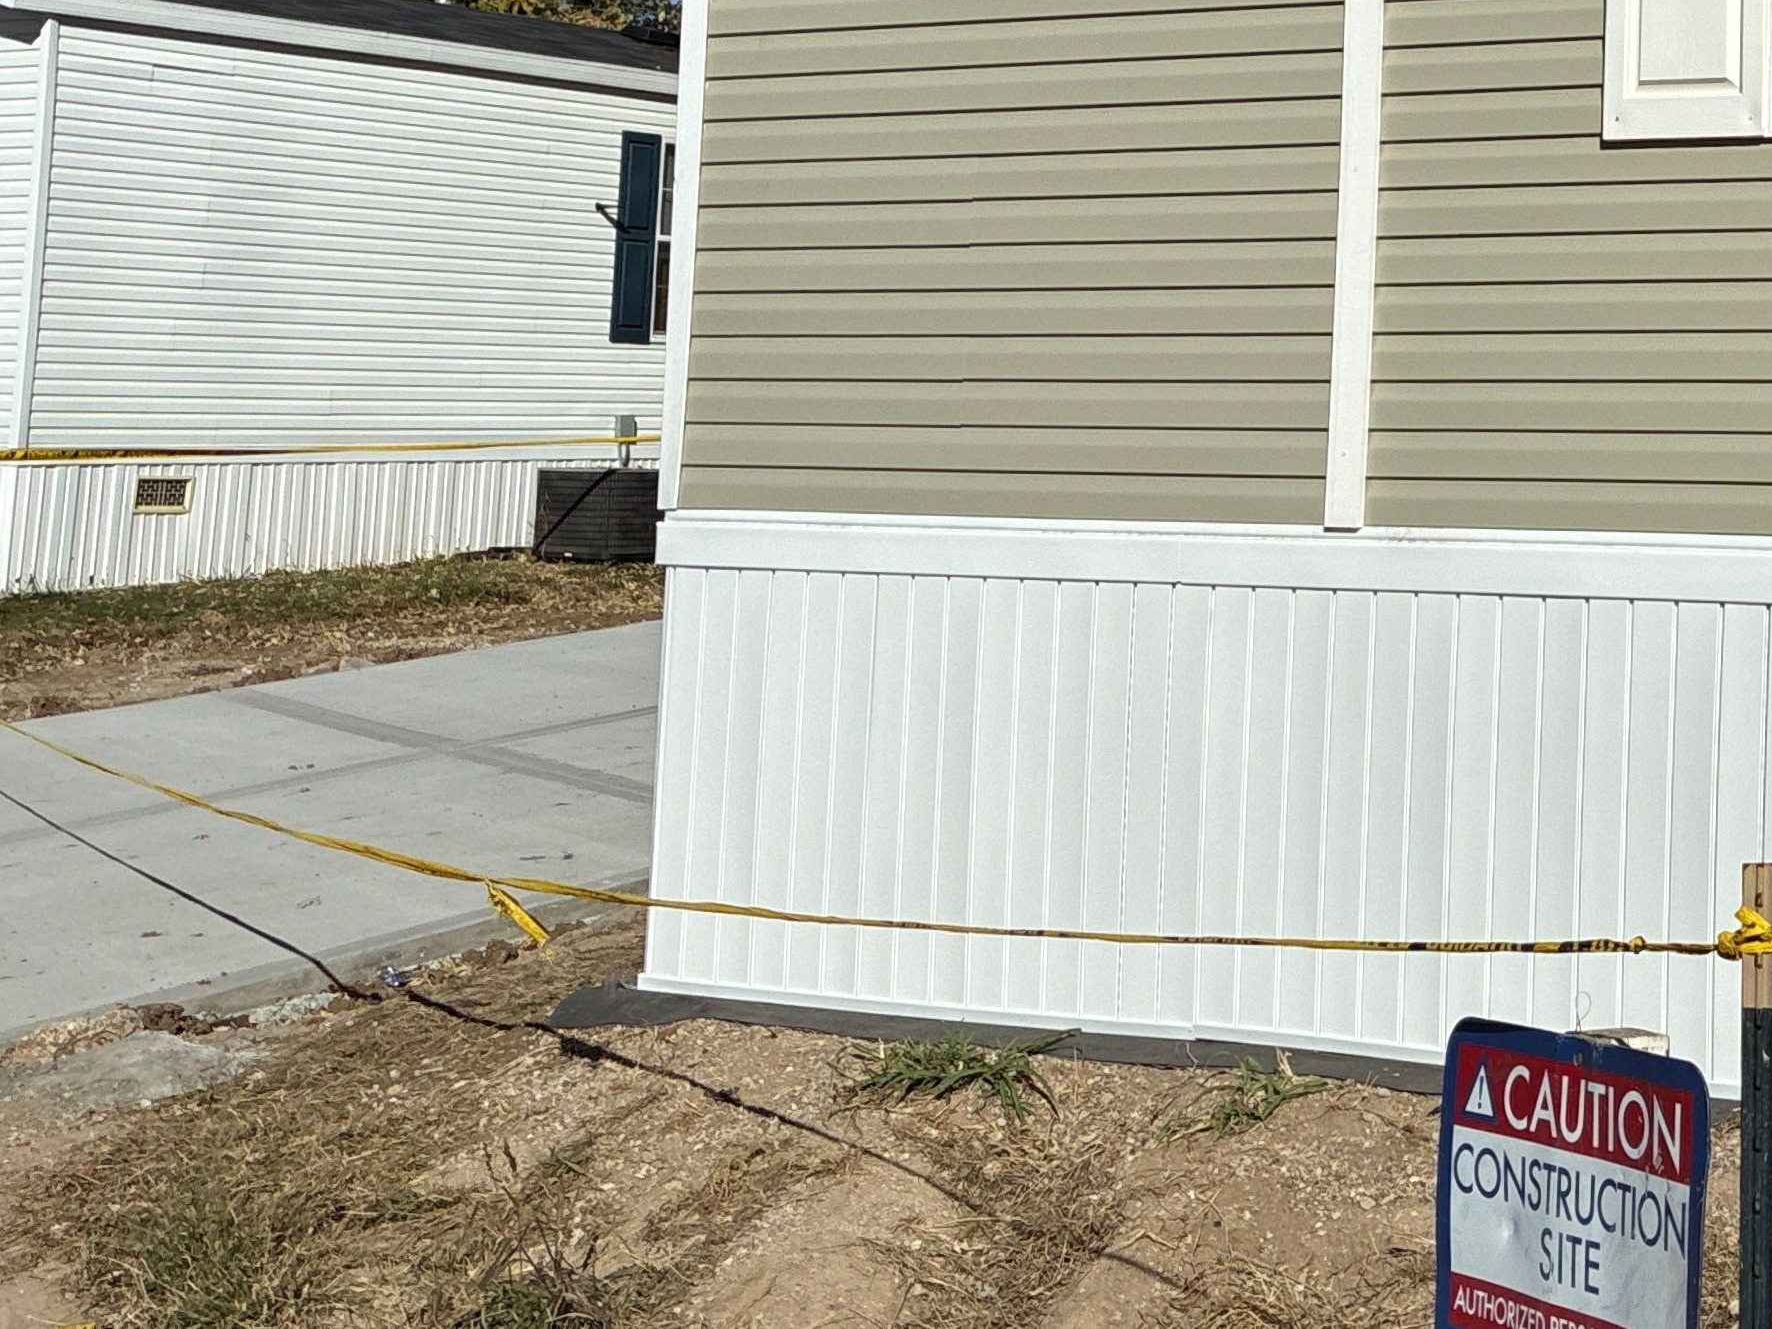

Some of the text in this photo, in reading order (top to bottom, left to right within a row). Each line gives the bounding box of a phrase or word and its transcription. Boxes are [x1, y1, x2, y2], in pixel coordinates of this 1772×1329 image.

[1504, 1065, 1682, 1175] CAUTION
[1454, 1142, 1686, 1260] CONSTRUCTION
[1539, 1227, 1600, 1295] SITE
[1453, 1284, 1546, 1329] AUTHORIZED
